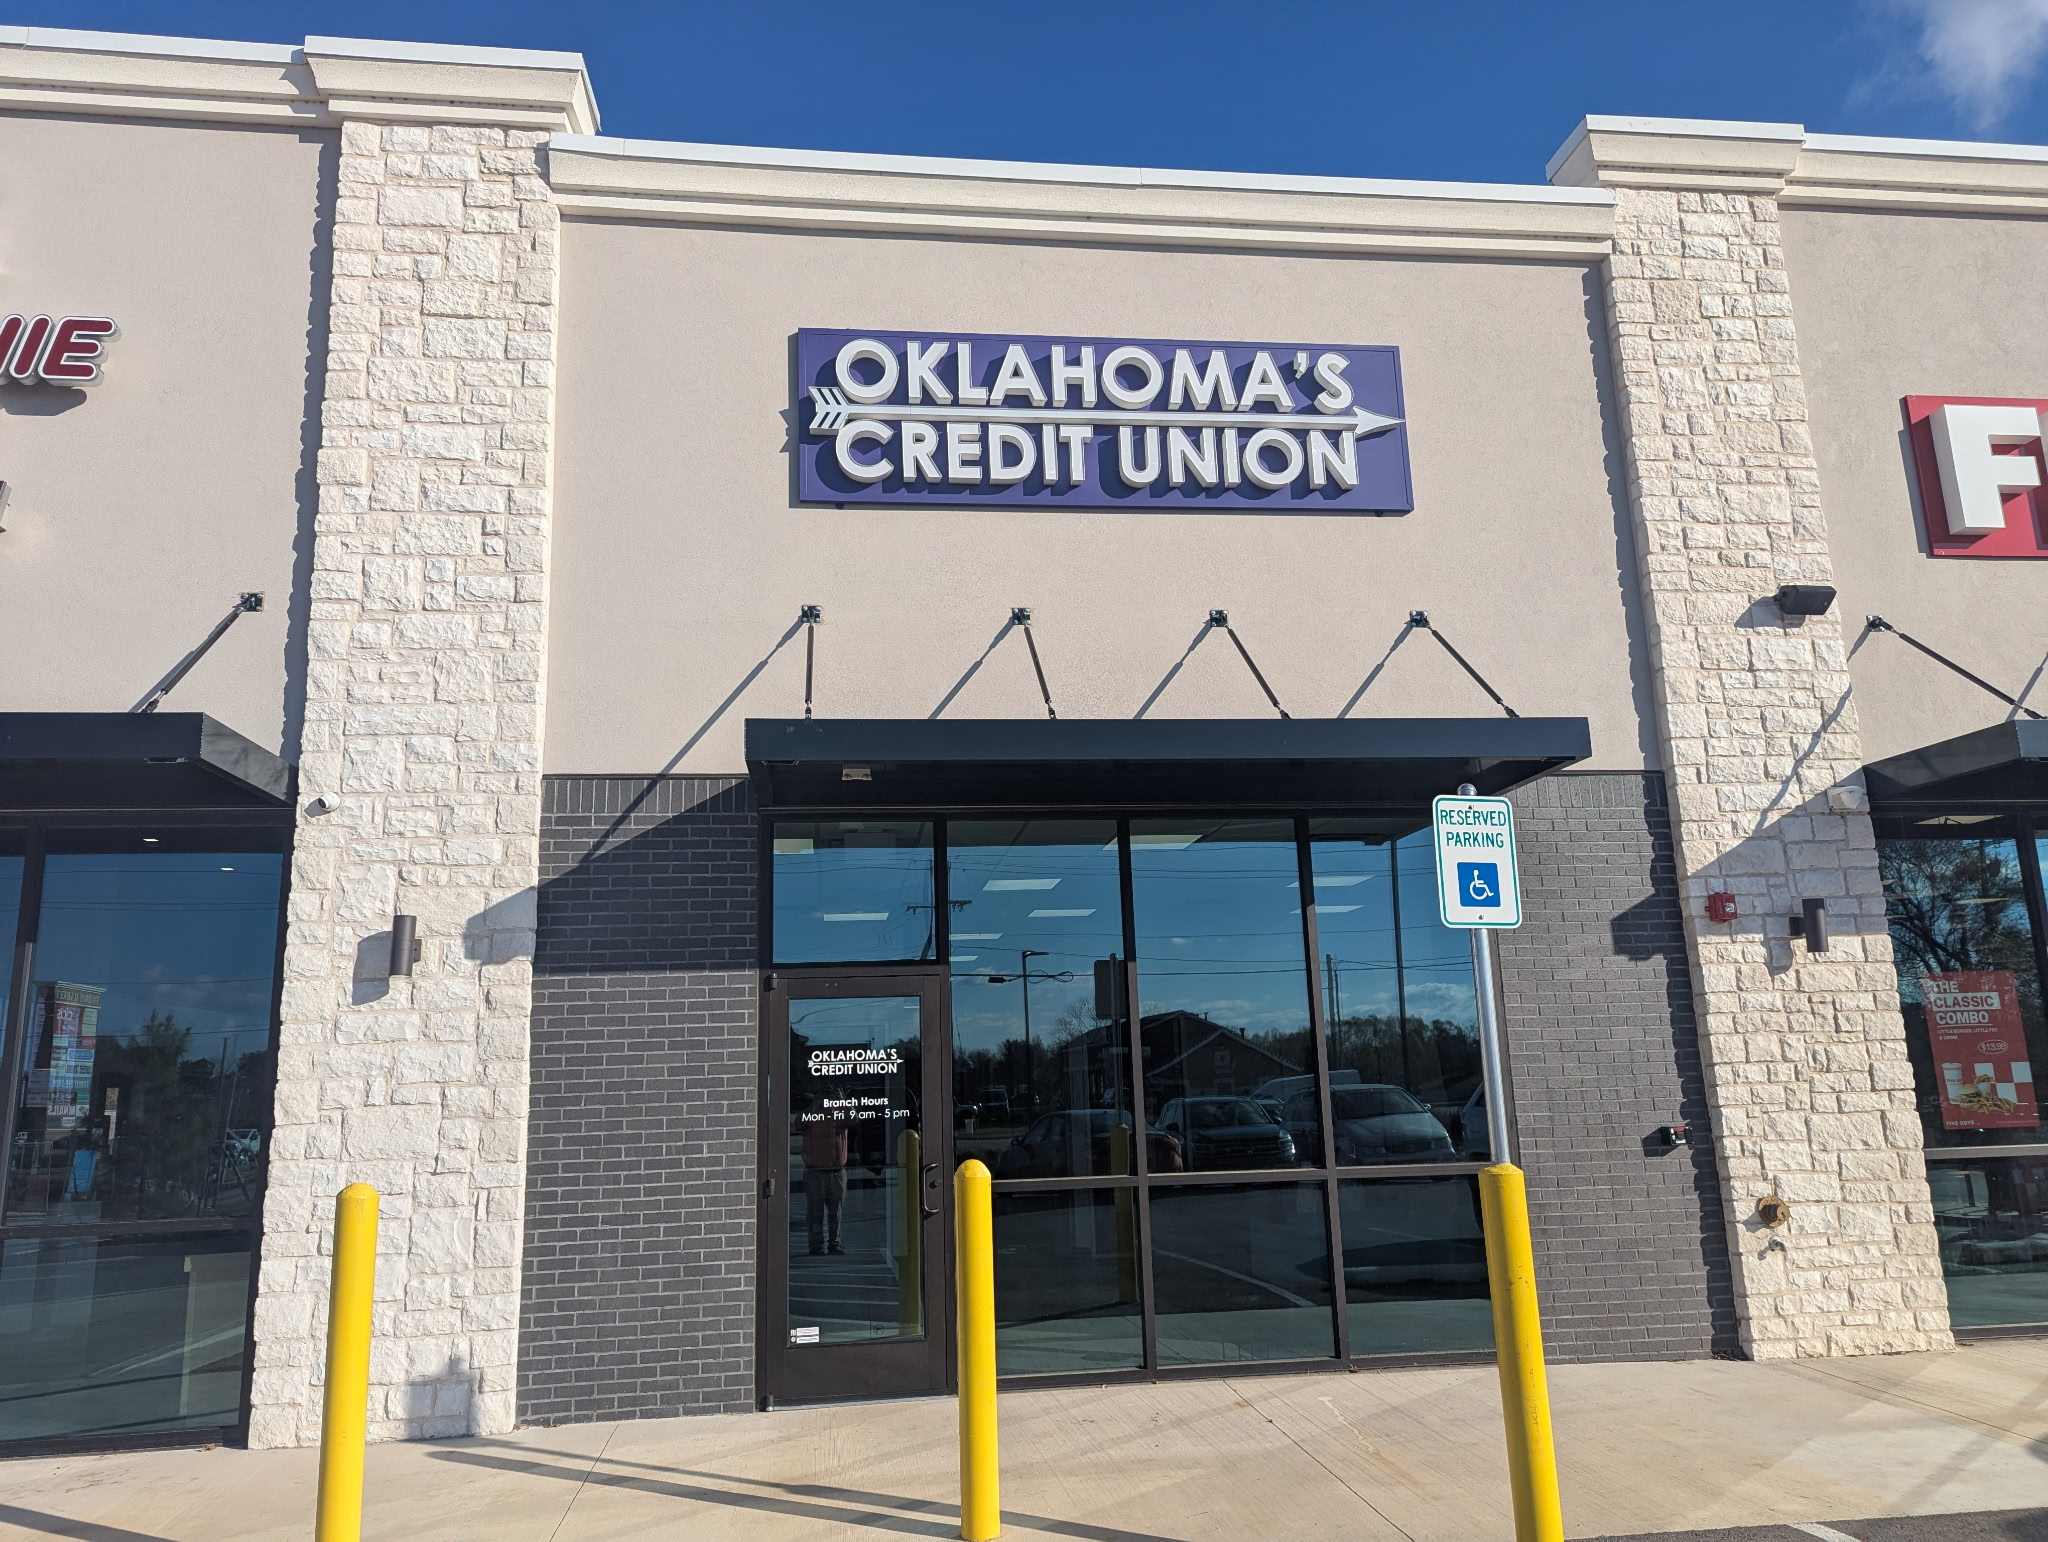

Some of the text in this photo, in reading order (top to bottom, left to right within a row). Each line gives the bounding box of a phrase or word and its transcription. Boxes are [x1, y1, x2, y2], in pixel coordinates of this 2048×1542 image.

[835, 338, 1354, 415] OKLAHOMA'S
[835, 419, 1359, 491] CREDIT UNION
[1440, 809, 1507, 827] RESERVED
[1446, 831, 1504, 849] PARKING
[1933, 995, 1995, 1009] CLASSIC
[1935, 1010, 1989, 1025] COMBO
[811, 1048, 898, 1062] OKLAHOMA'S
[811, 1063, 897, 1076] CREDIT UNION
[823, 1096, 889, 1108] Branch Hours
[801, 1112, 825, 1122] Mon
[833, 1110, 845, 1120] Fri
[849, 1110, 856, 1120] 9
[858, 1110, 876, 1119] am
[884, 1108, 891, 1118] 5
[893, 1109, 910, 1119] pm
